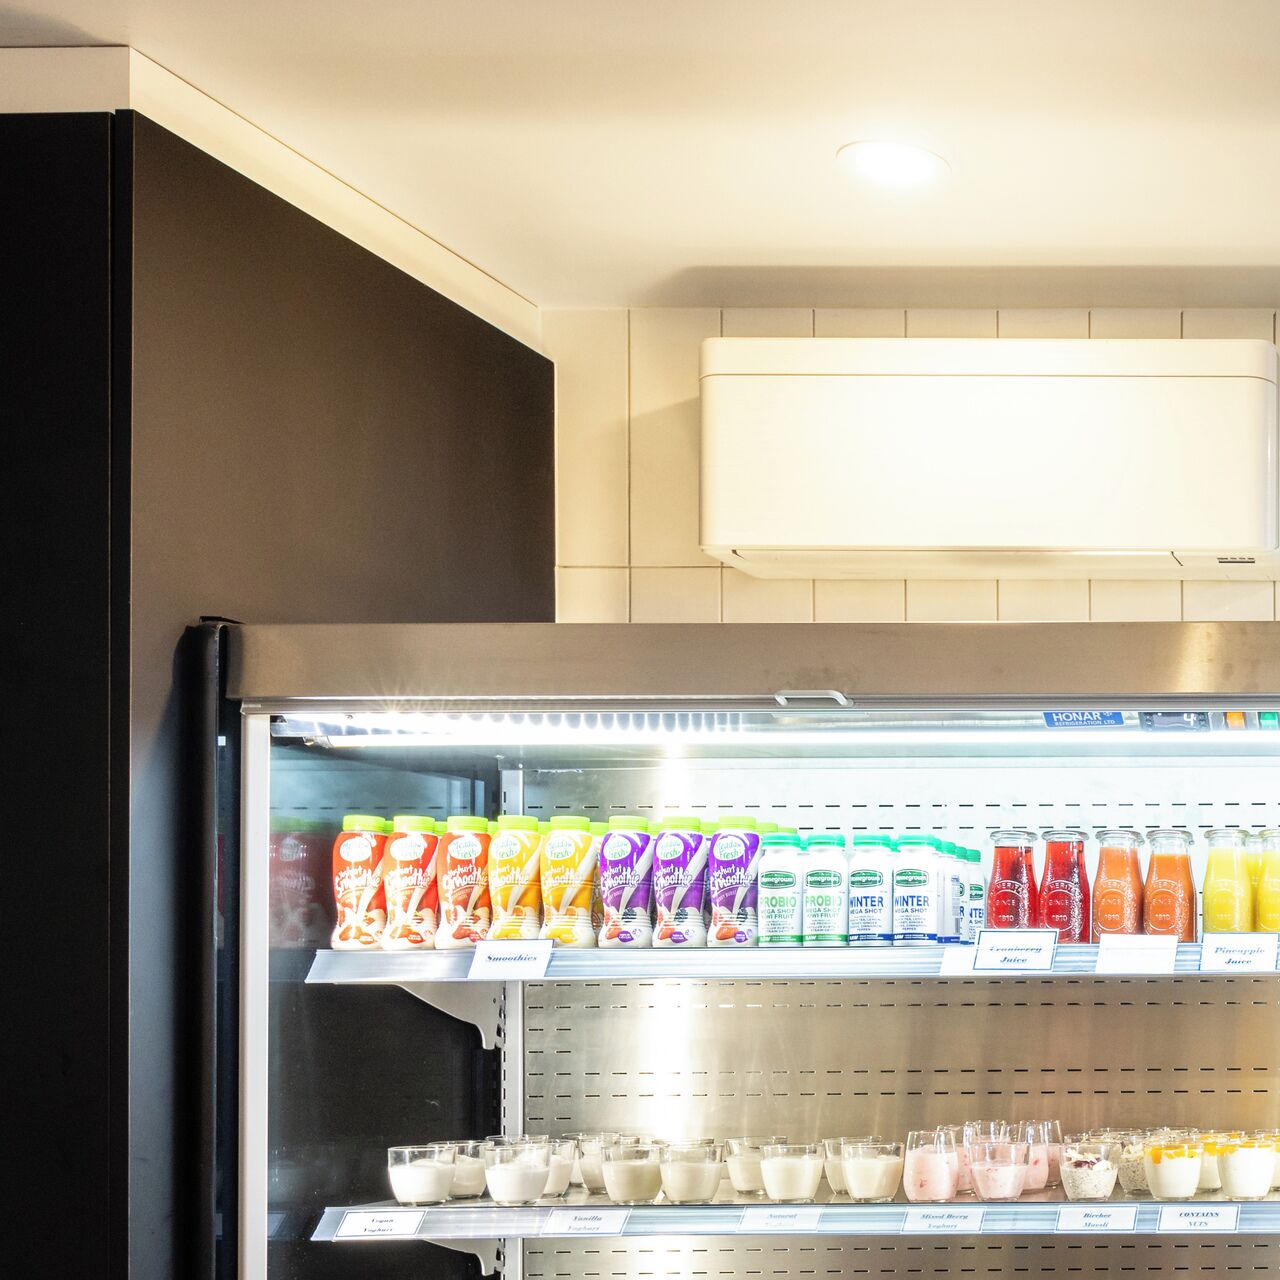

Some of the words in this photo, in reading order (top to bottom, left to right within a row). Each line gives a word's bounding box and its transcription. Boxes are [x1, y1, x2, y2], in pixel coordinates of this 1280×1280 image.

[1052, 712, 1102, 722] HONAR
[850, 896, 884, 907] WINTER
[895, 895, 930, 907] WINTER
[1214, 946, 1265, 955] Pineapple
[487, 954, 537, 962] Smoothies
[1224, 957, 1252, 965] Juice
